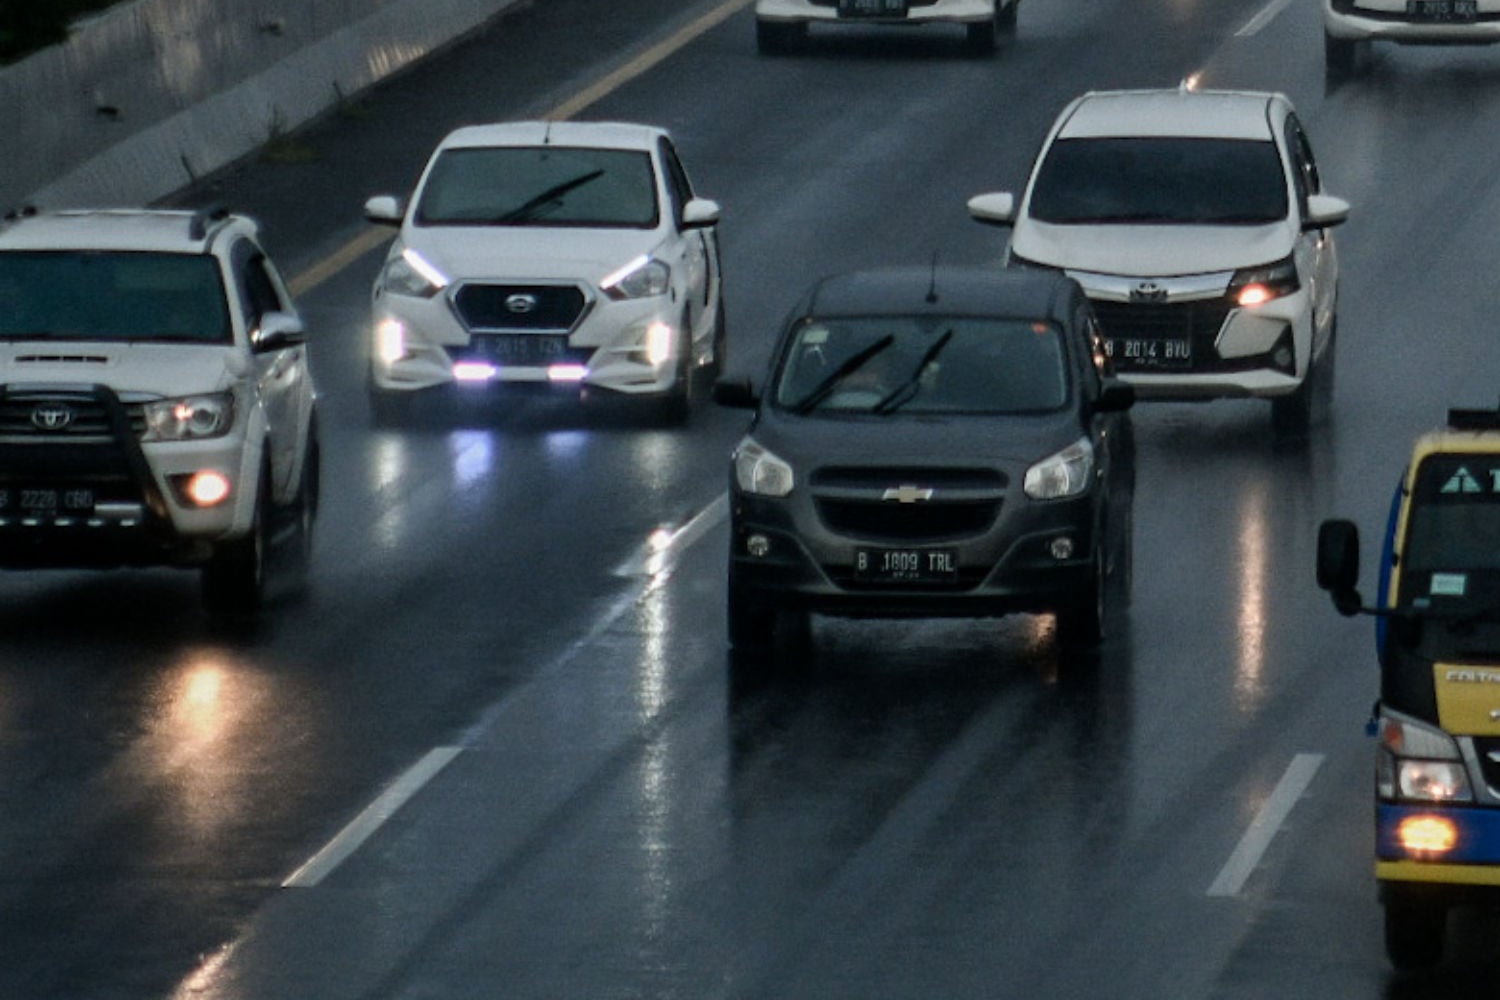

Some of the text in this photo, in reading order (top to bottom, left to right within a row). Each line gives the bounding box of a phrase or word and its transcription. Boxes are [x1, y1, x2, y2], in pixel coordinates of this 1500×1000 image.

[1124, 339, 1158, 358] 2014
[858, 551, 868, 571] B
[928, 553, 954, 573] TRL
